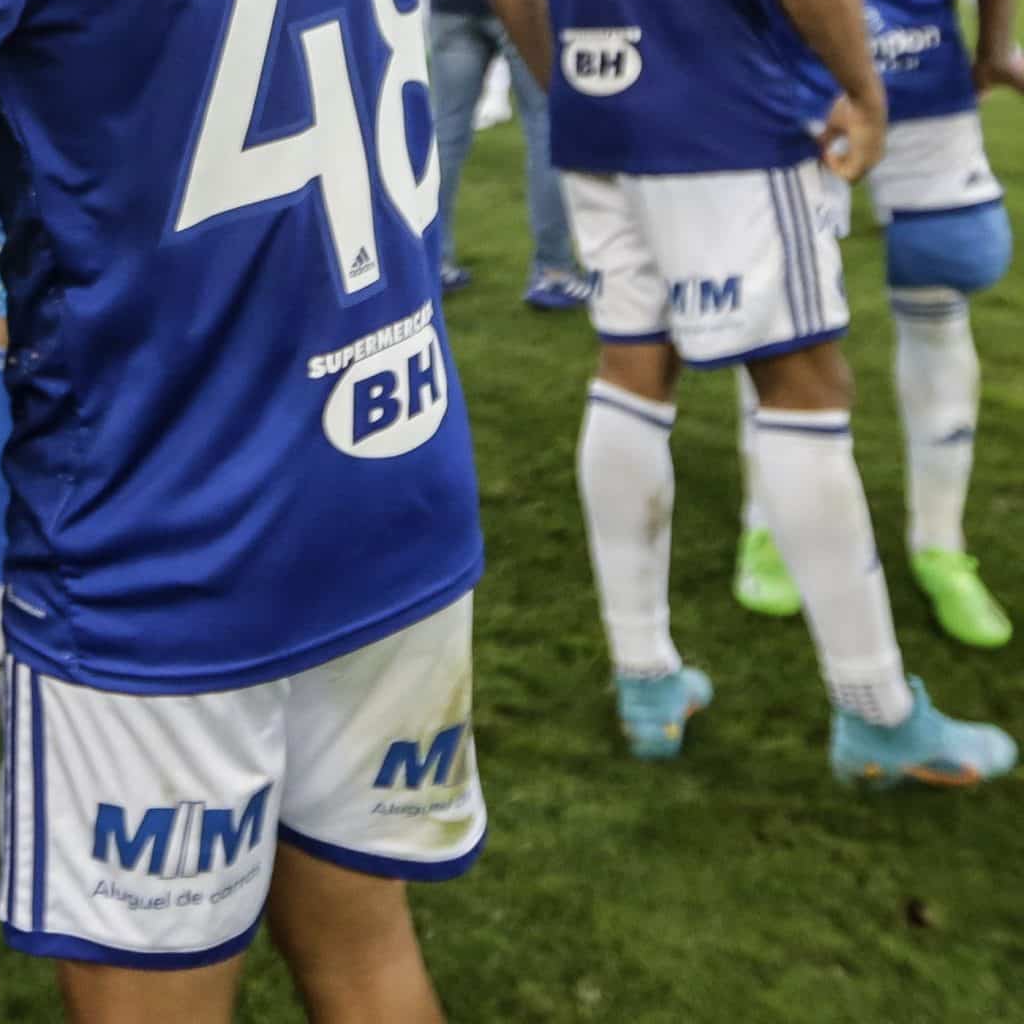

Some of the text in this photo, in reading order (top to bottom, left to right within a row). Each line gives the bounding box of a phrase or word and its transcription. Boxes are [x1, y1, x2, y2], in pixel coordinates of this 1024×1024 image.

[352, 335, 442, 446] BH
[91, 879, 172, 911] Aluguel
[176, 879, 203, 907] de
